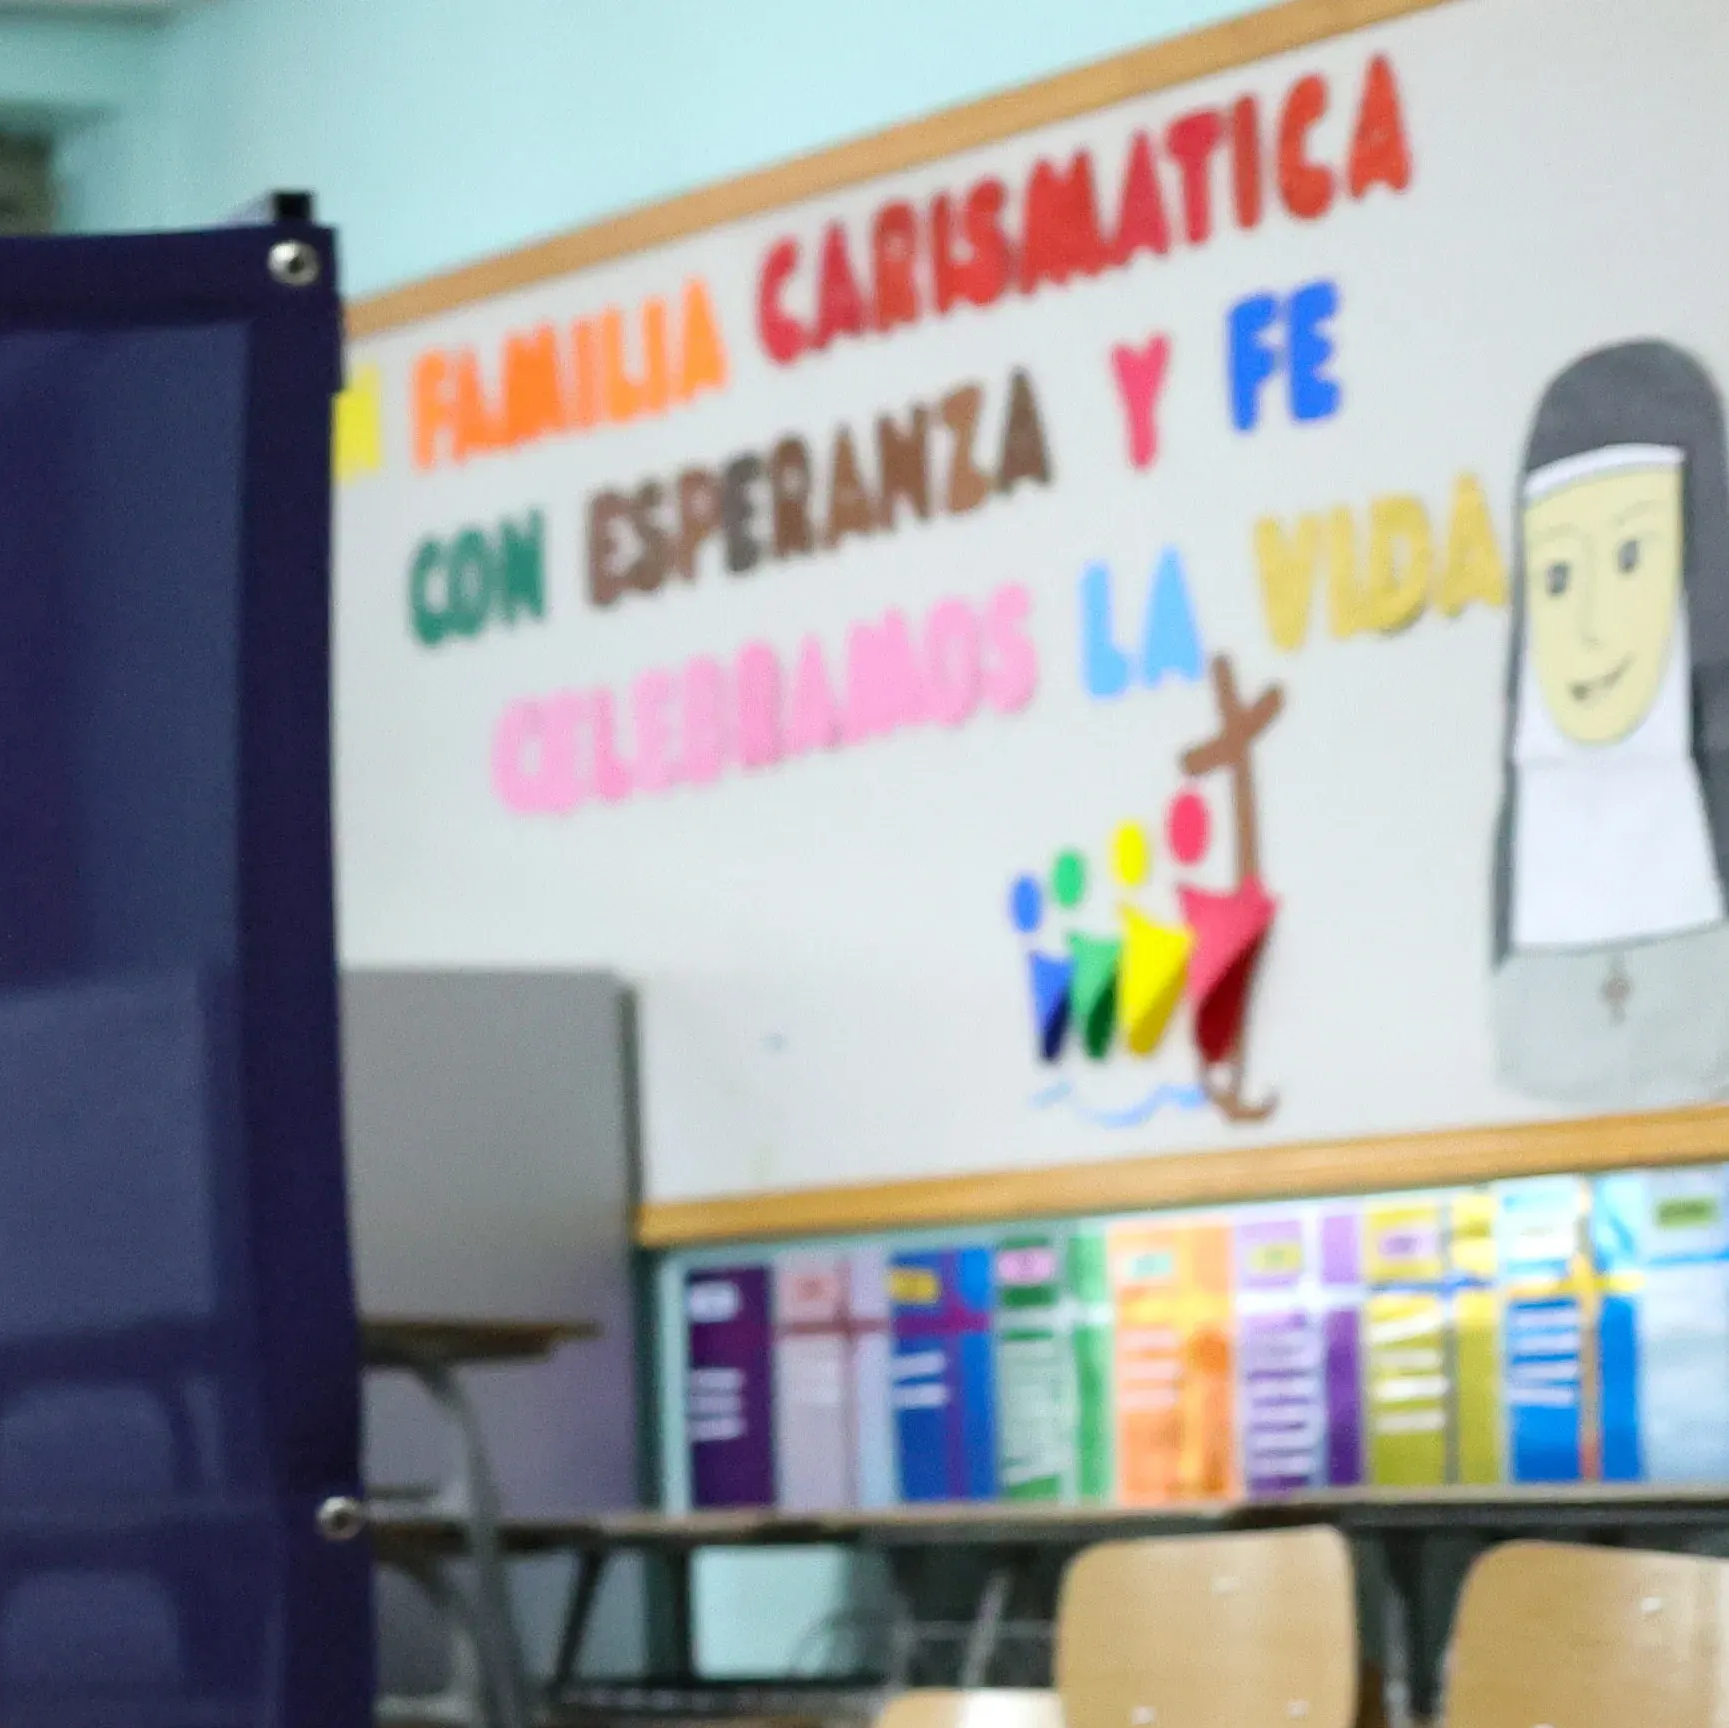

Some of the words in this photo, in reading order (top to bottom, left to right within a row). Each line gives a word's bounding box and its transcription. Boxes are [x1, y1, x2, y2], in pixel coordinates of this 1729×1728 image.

[410, 277, 730, 470] FAMILIA
[754, 54, 1413, 366] CARISMATICA
[410, 512, 547, 647] CON
[587, 370, 1051, 606] ESPERANZA
[1111, 334, 1171, 471] Y
[1223, 278, 1344, 434] FE
[1077, 546, 1206, 701] LA
[1254, 474, 1509, 651] VIDA
